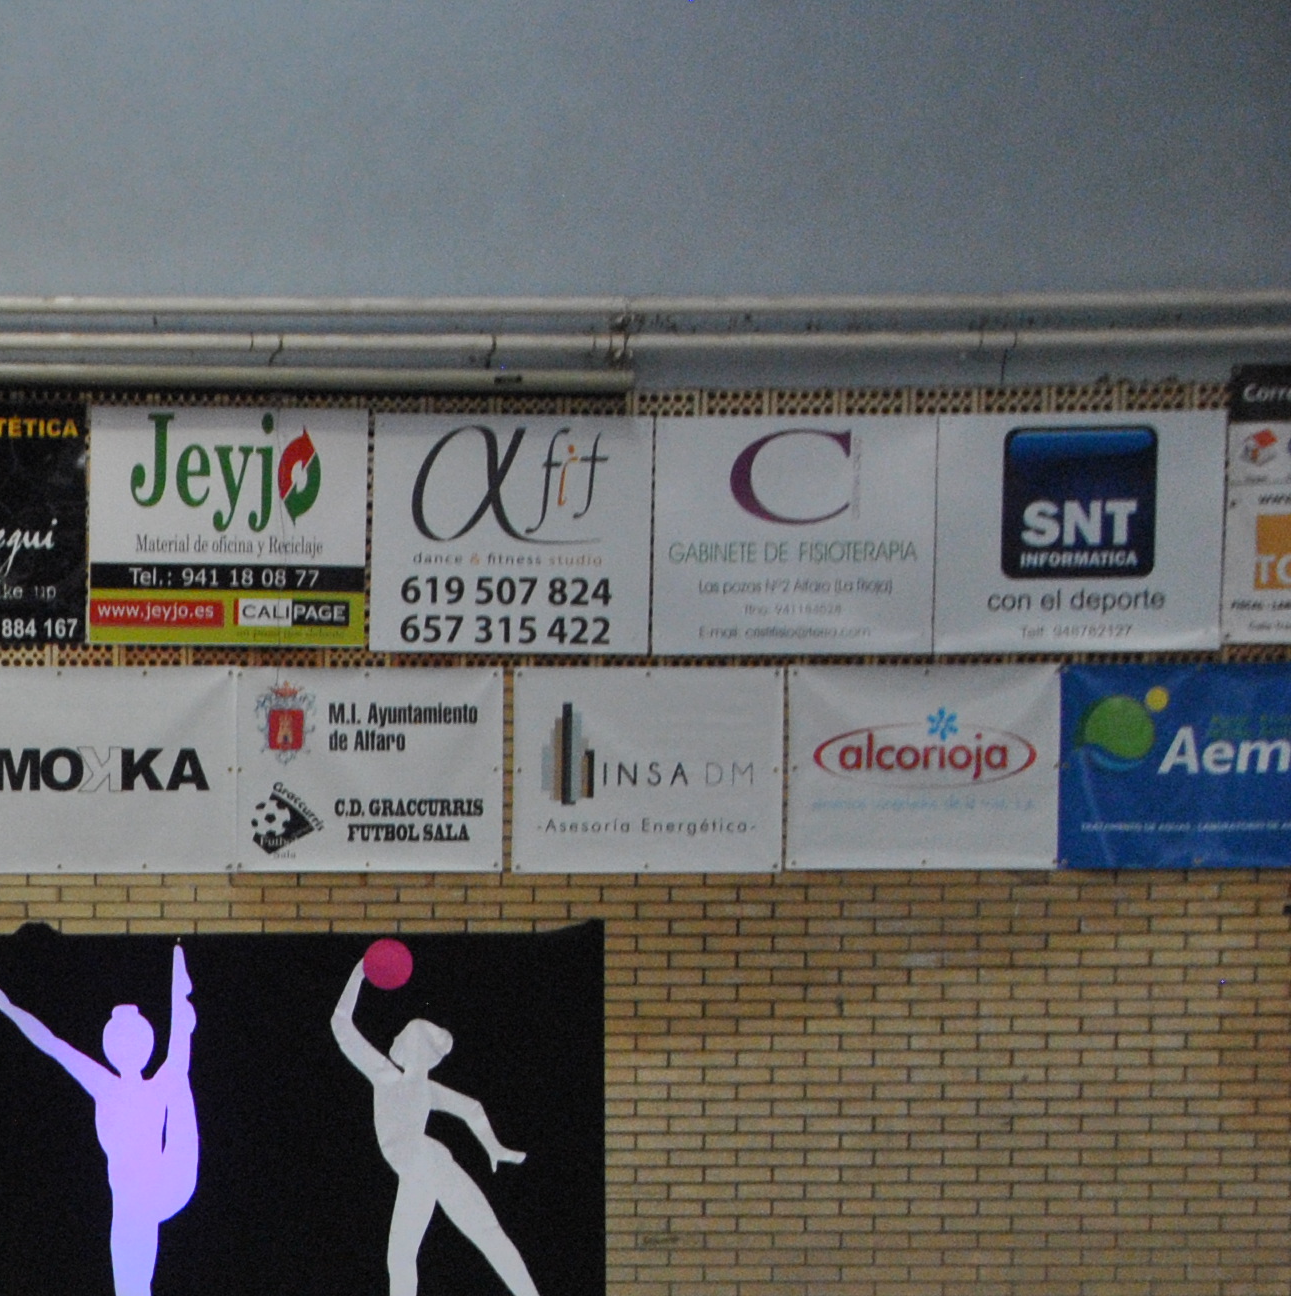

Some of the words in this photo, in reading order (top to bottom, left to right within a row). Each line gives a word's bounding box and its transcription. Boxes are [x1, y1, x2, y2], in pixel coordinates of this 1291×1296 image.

[1020, 500, 1137, 547] SNT
[135, 534, 191, 554] Material
[194, 535, 209, 553] de
[257, 541, 266, 558] y
[669, 541, 757, 564] GABINETE
[764, 542, 789, 563] DE
[798, 540, 917, 564] FISIOTERAPIA
[413, 552, 462, 565] dance
[488, 553, 541, 566] fitness
[549, 554, 603, 567] studio
[1020, 551, 1139, 568] INFORMATICA
[181, 568, 219, 586] 941
[230, 569, 254, 587] 18
[261, 569, 287, 588] 08
[295, 570, 320, 588] 77
[400, 575, 465, 605] 619
[475, 576, 538, 606] 507
[547, 577, 612, 607] 824
[987, 593, 1031, 611] con
[1040, 589, 1061, 610] el
[1070, 588, 1166, 614] deporte
[97, 602, 215, 621] www.jeyjo.es
[1, 617, 37, 639] 884
[44, 617, 79, 639] 167
[399, 614, 464, 644] 657
[474, 614, 537, 644] 315
[546, 616, 611, 645] 422
[328, 702, 362, 725] M.I.
[367, 702, 479, 728] Ayuntamiento
[329, 730, 349, 751] de
[353, 730, 406, 752] Alfaro
[838, 730, 1009, 781] alcorioja
[602, 761, 689, 787] INSA
[705, 762, 755, 787] DM
[333, 798, 365, 817] C.D.
[368, 798, 484, 817] GRACCURRIS
[347, 822, 420, 842] FUTBOL
[422, 823, 471, 842] SALA
